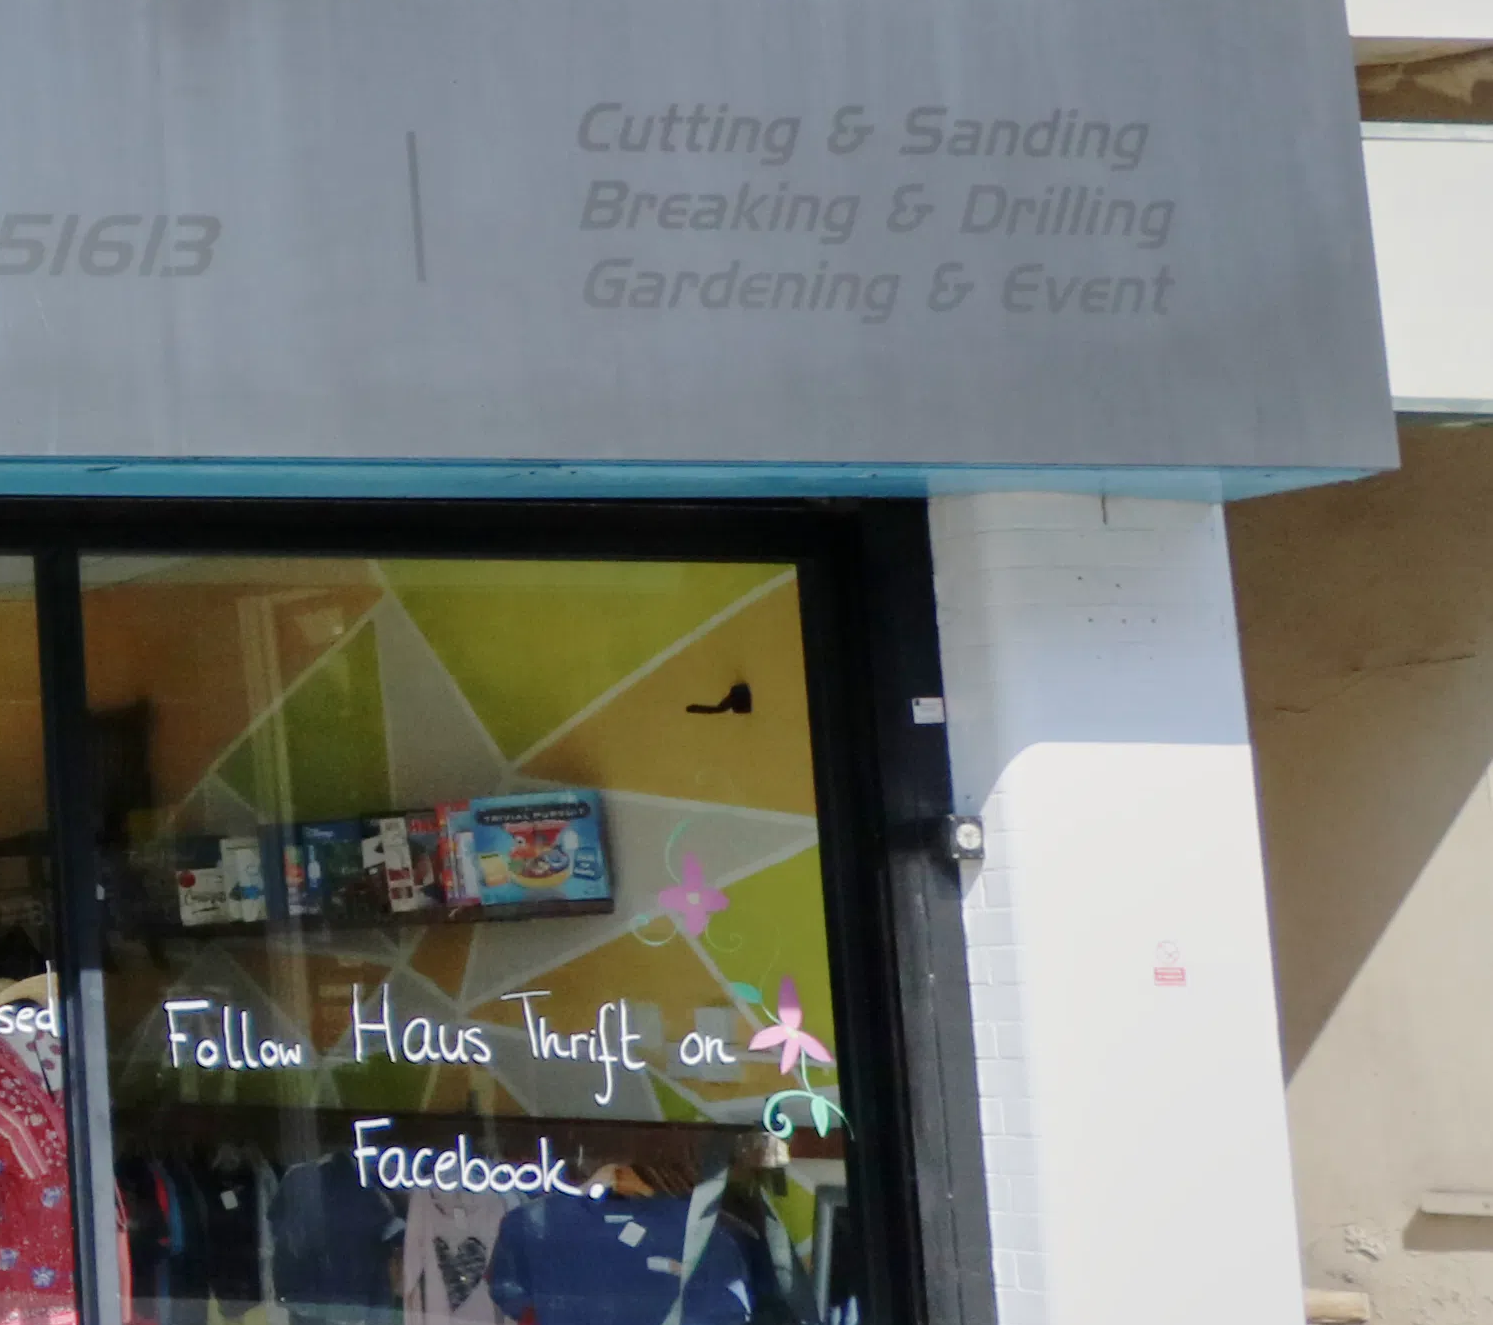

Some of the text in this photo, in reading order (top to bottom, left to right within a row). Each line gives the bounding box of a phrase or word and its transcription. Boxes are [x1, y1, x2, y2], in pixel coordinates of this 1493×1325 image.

[575, 102, 1151, 172] Cutting & Sanding
[577, 178, 1177, 251] Breaking & Drilling
[581, 257, 1177, 325] Gardening & Event
[163, 982, 736, 1106] Follow Haus Thrift on
[351, 1118, 610, 1202] Facebook.
